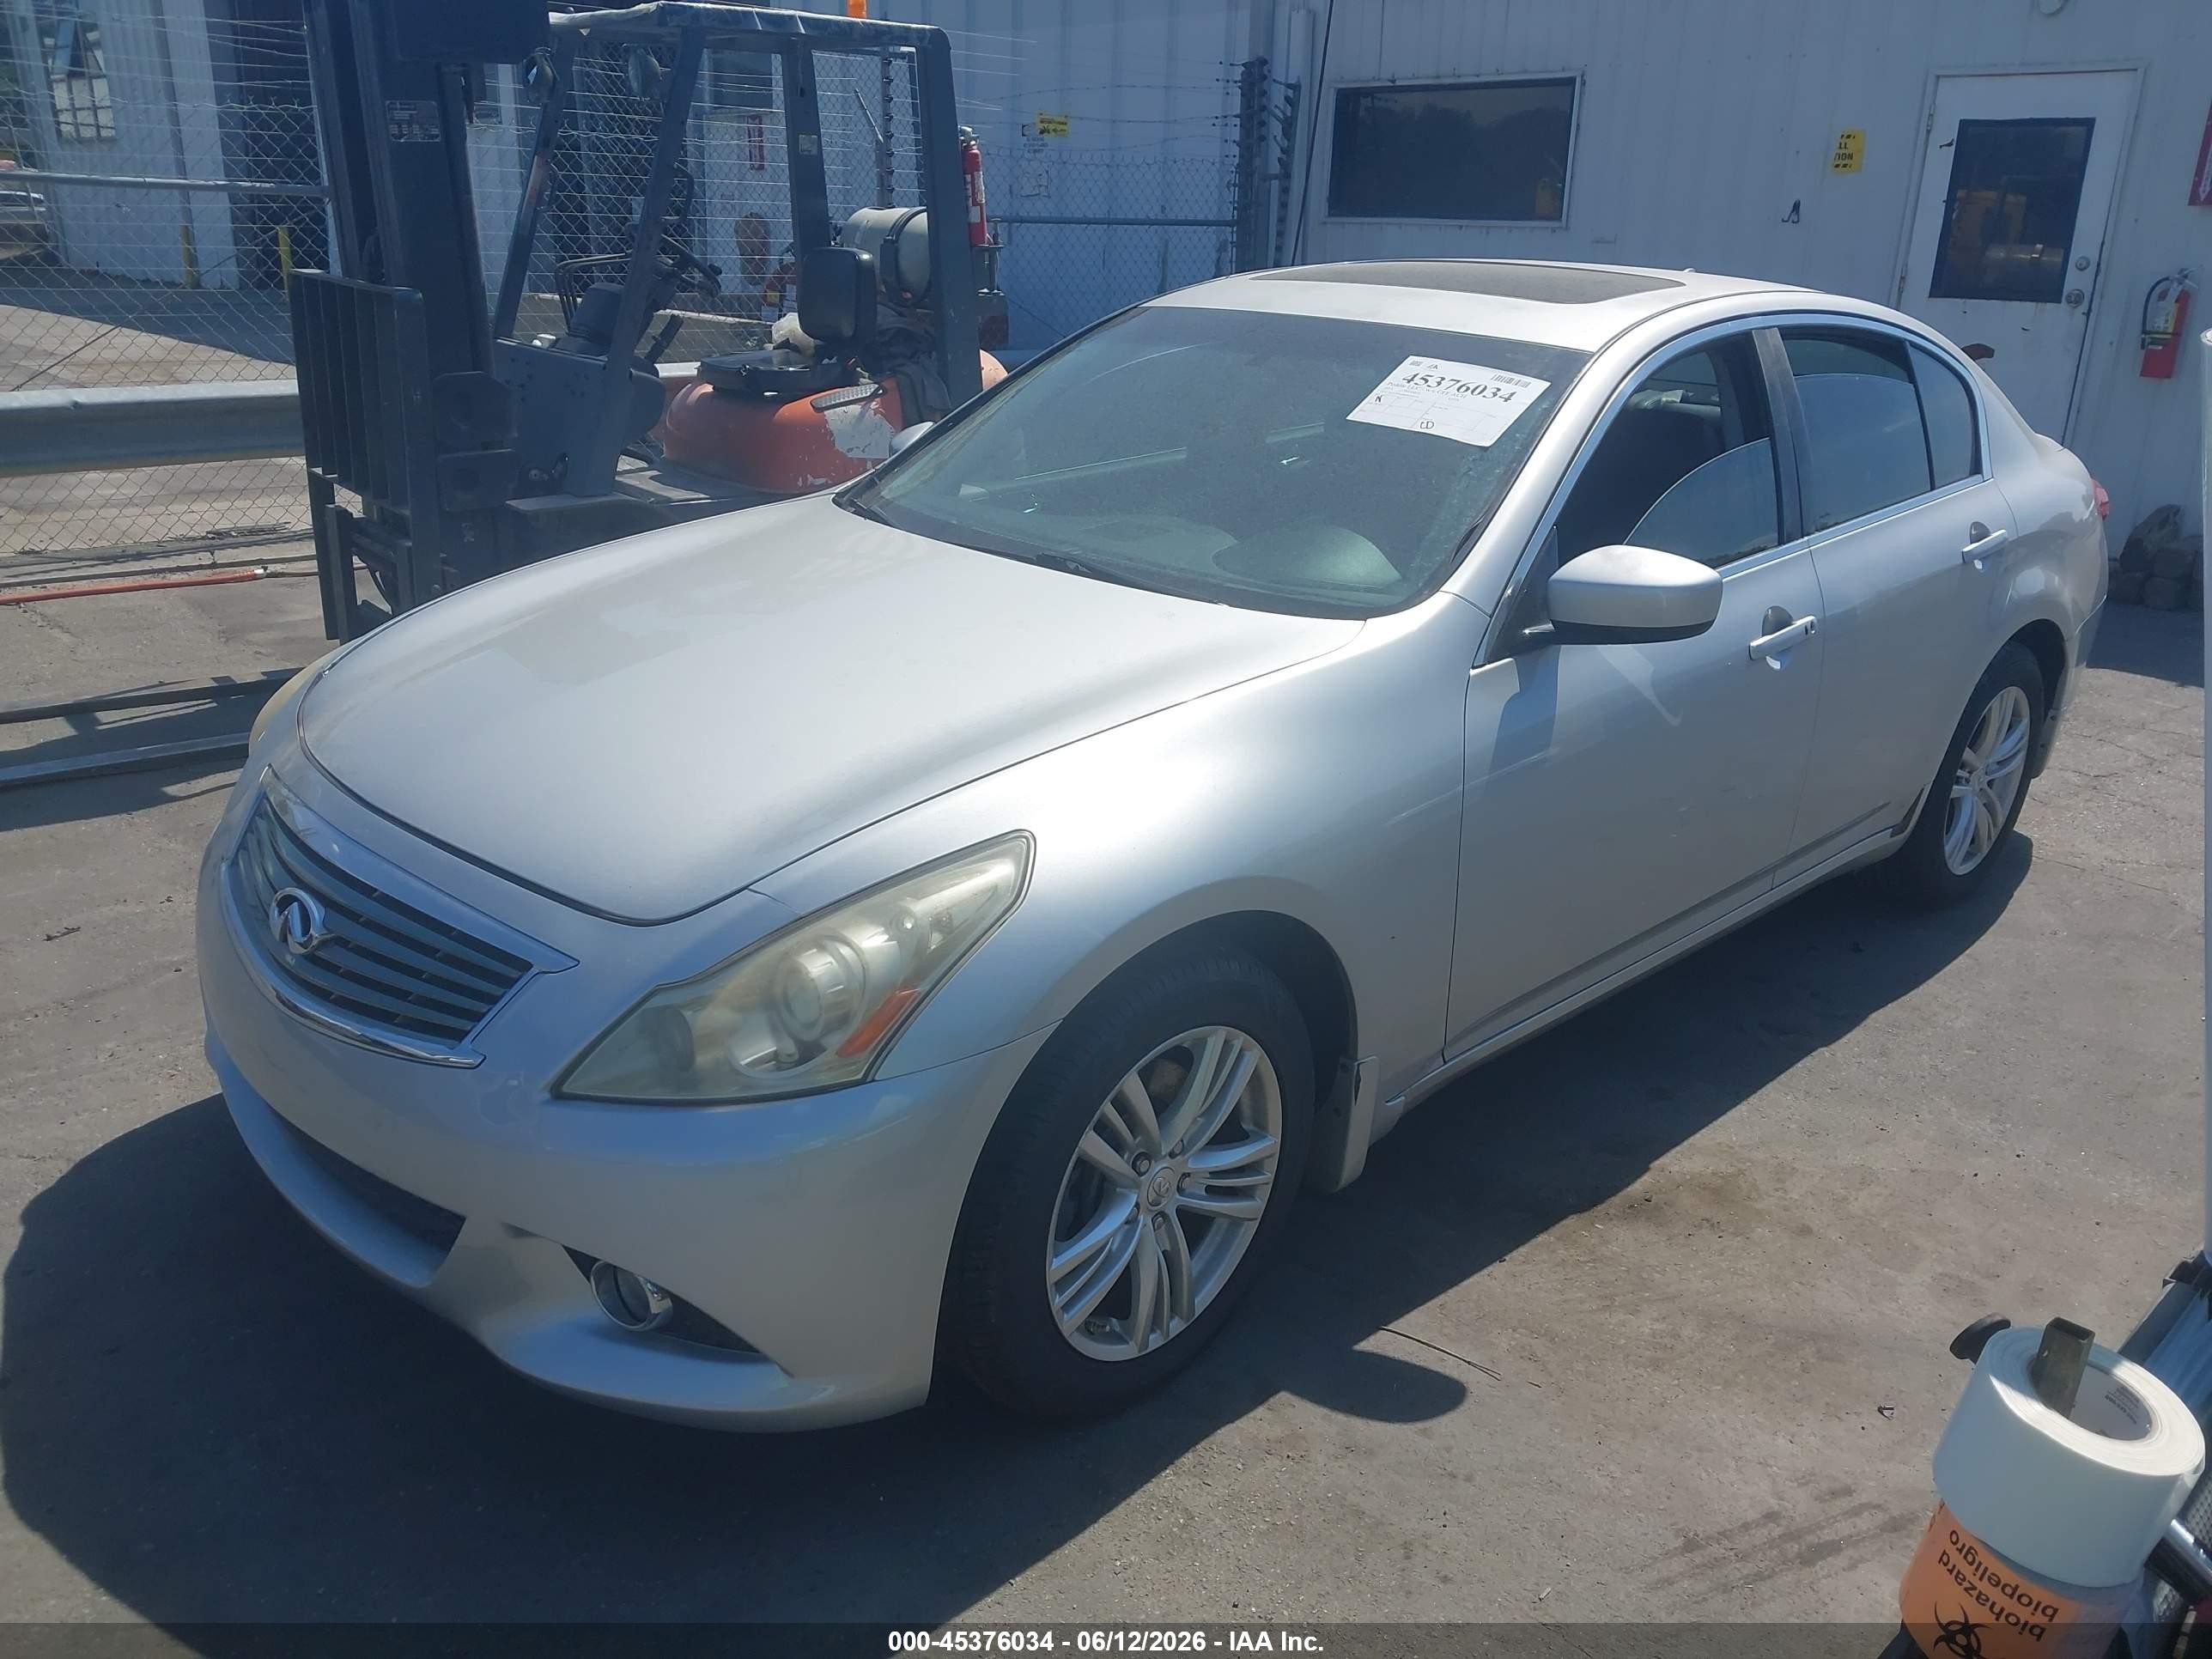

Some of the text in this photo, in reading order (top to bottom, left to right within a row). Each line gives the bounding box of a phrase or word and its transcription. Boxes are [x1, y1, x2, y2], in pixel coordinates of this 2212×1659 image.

[1401, 372, 1517, 403] 45376034
[1938, 1549, 2047, 1642] biohazard
[1949, 1529, 2059, 1622] biopeligro
